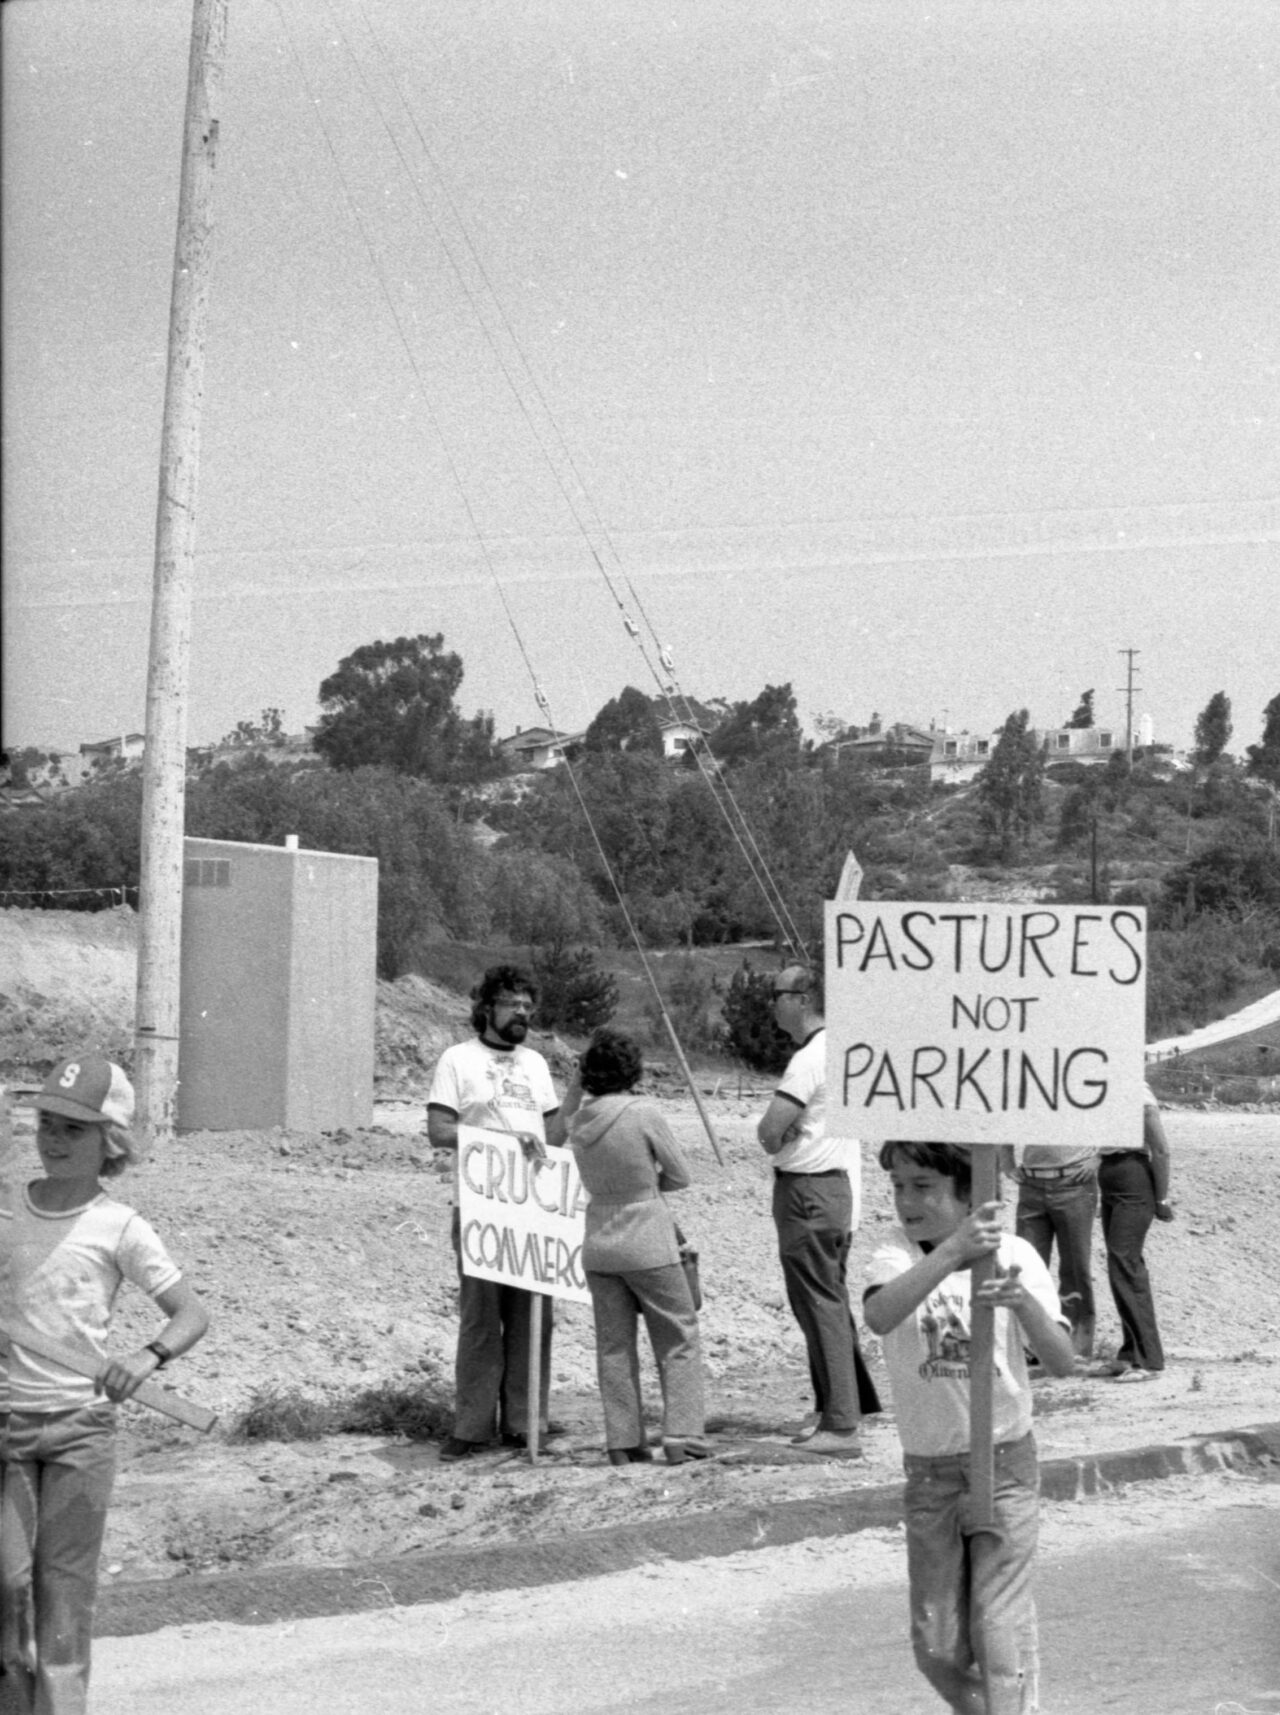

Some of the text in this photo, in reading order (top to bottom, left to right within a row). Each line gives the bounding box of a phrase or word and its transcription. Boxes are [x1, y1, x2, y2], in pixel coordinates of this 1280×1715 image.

[835, 910, 1143, 986] PASTURES
[952, 993, 1040, 1033] NOT
[59, 1063, 81, 1088] S
[843, 1042, 1109, 1113] PARKING
